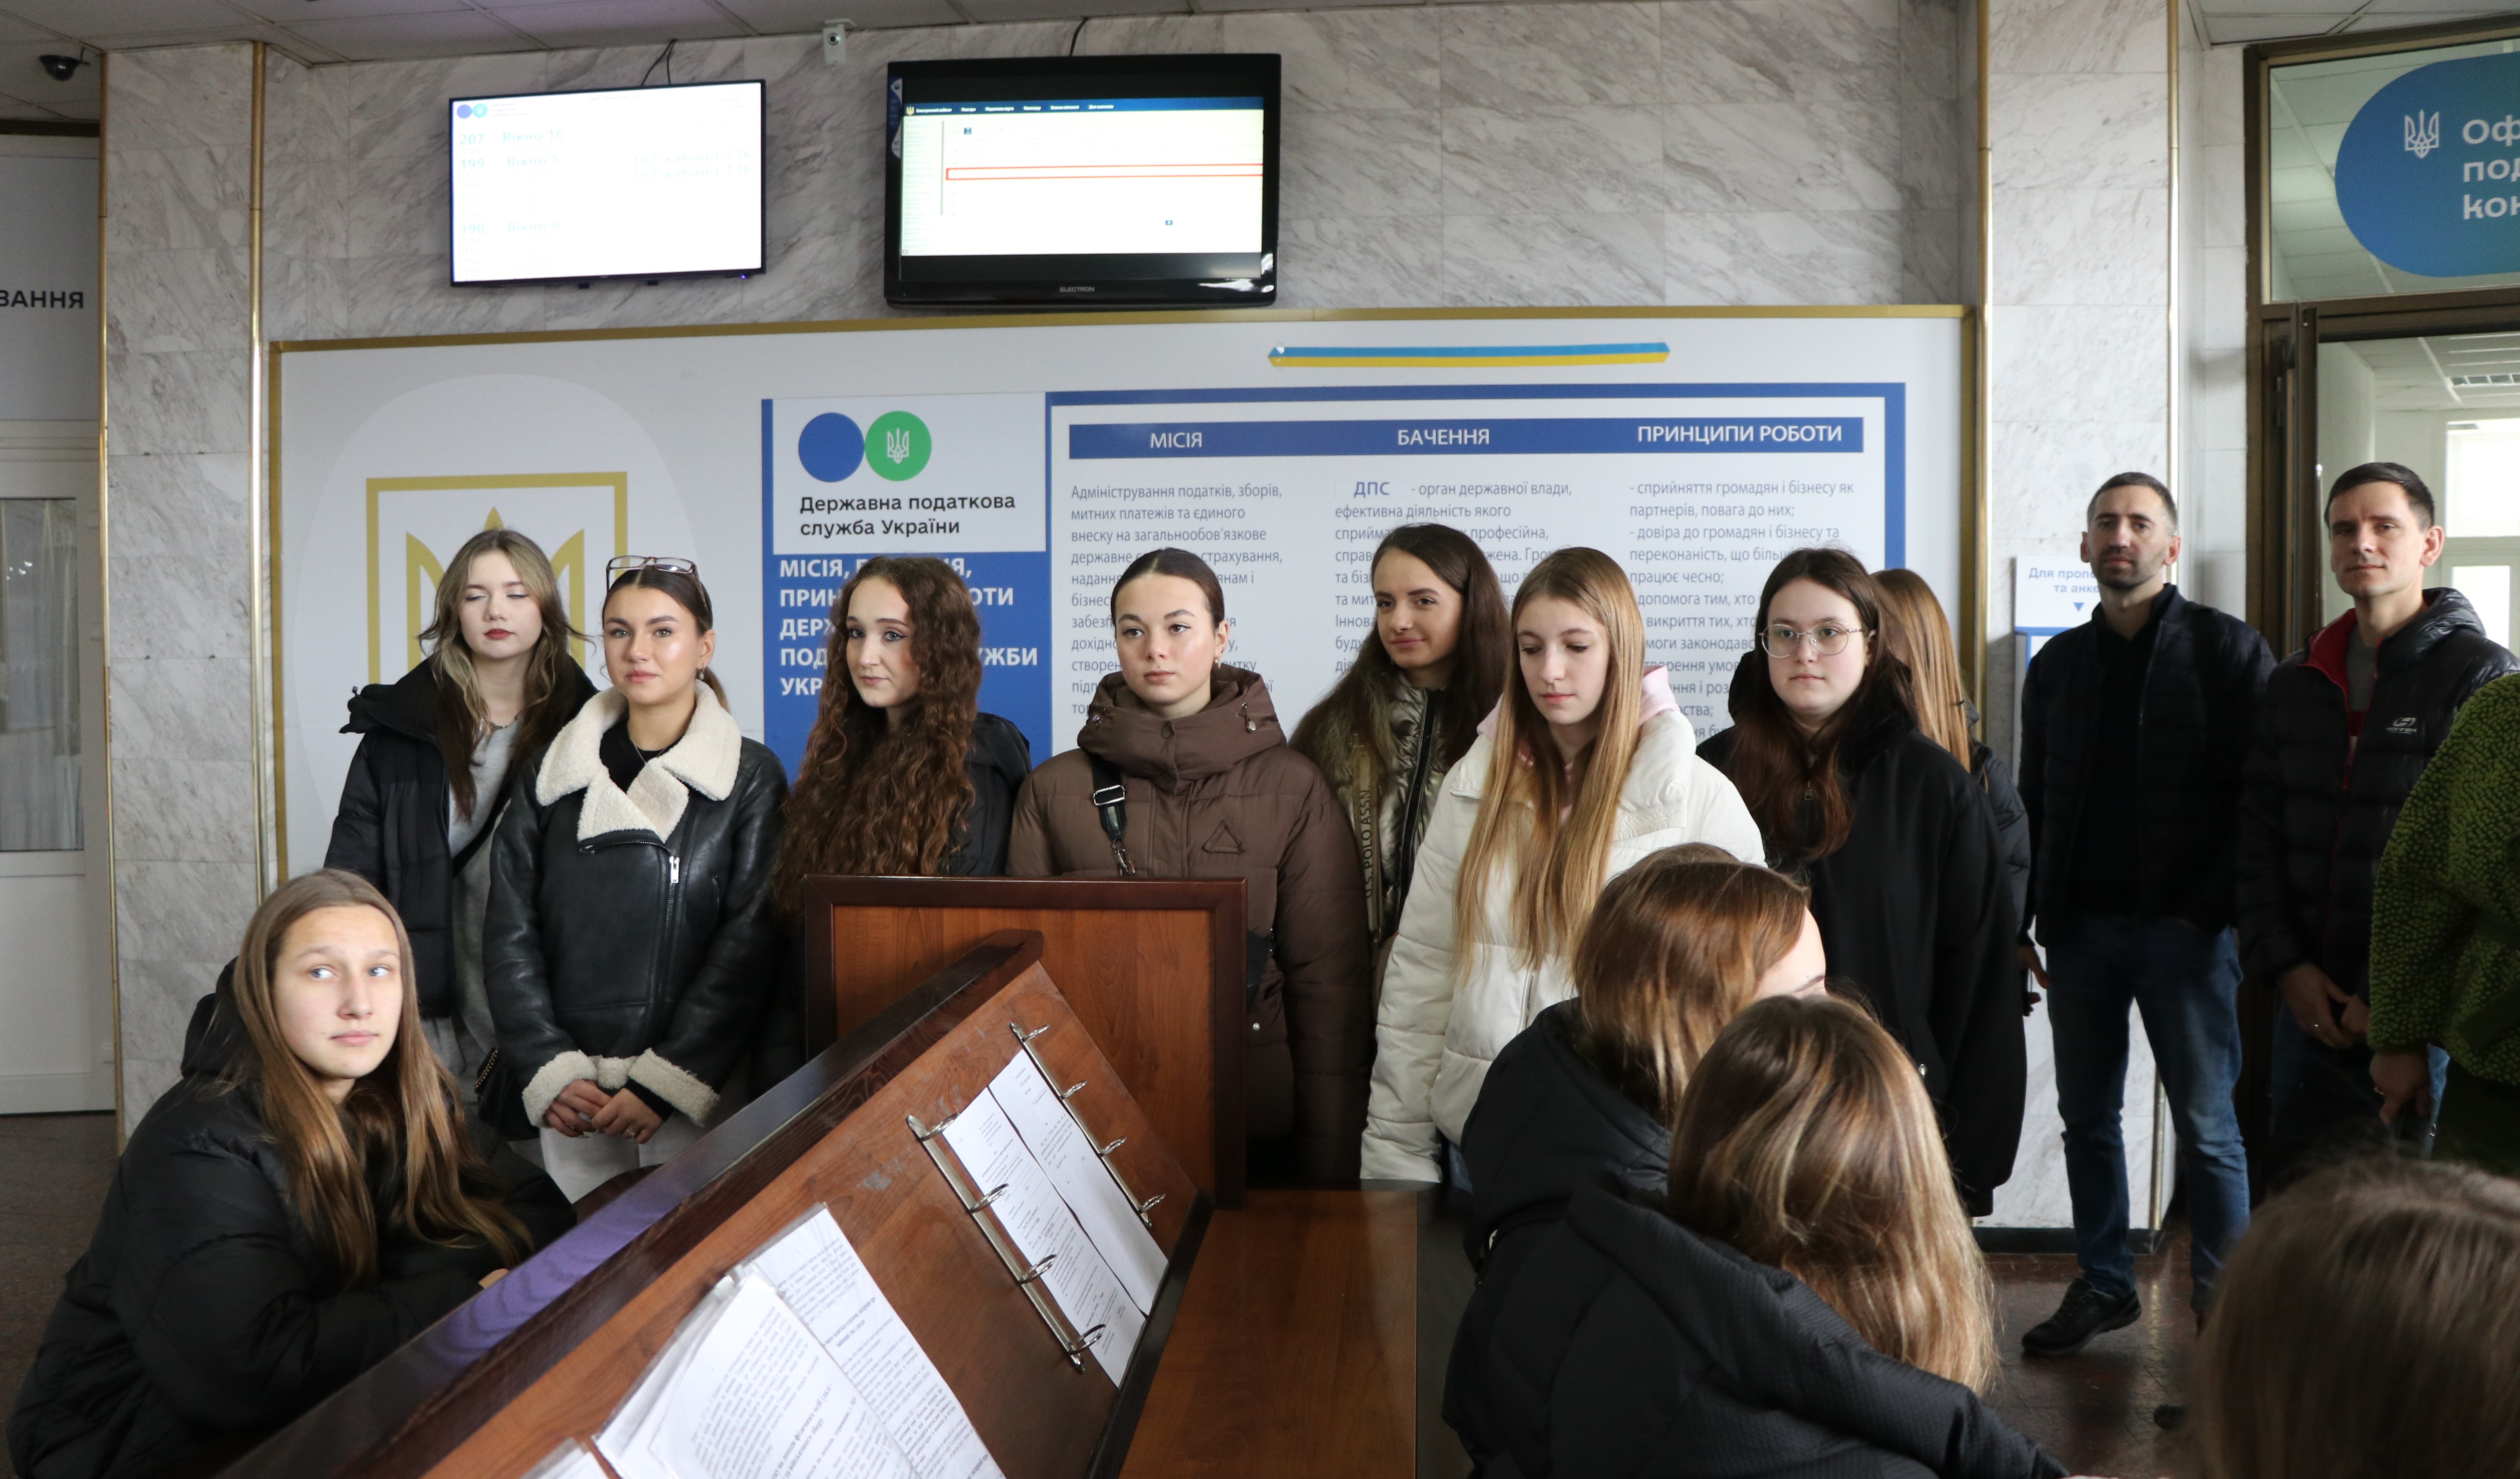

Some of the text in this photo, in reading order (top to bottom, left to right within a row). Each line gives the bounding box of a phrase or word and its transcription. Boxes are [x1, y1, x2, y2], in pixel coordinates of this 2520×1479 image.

[460, 129, 564, 145] 207 Вікно 16
[461, 154, 558, 169] 199 Вікно 5
[461, 220, 559, 234] 190 Вікно 6
[1150, 432, 1203, 448] МІСІЯ
[1398, 429, 1490, 446] БАЧЕННЯ
[1638, 425, 1842, 444] ПРИНЦИПИ РОБОТИ
[1071, 483, 1282, 501] Адміністрування податків, зборів,
[1354, 482, 1390, 498] ДПС
[1419, 485, 1456, 497] орган
[1459, 482, 1529, 496] державної
[1532, 484, 1572, 496] влади,
[1638, 481, 1713, 496] сприйняття
[1717, 484, 1778, 496] громадян
[1782, 481, 1785, 493] і
[1789, 480, 1836, 497] бізнесу
[1839, 484, 1854, 494] як
[800, 495, 1015, 514] Державна податкова
[1630, 505, 1794, 519] партнерів, повага до них;
[1071, 507, 1245, 521] митних платежів та єдиного
[1335, 505, 1511, 521] ефективна діяльність якого
[800, 519, 960, 538] служба України
[1471, 524, 1549, 539] професійна,
[1638, 527, 1680, 541] довіра
[1684, 528, 1700, 541] до
[1703, 528, 1766, 541] громадян
[1769, 525, 1772, 538] і
[1776, 525, 1823, 541] бізнесу
[1827, 528, 1839, 538] та
[1071, 531, 1113, 545] внеску
[1116, 531, 1131, 541] на
[1071, 552, 1132, 566] державне
[1202, 551, 1283, 563] страхування,
[1630, 549, 1727, 563] переконаність,
[1731, 550, 1750, 562] що
[780, 559, 850, 579] МІСІЯ,
[2029, 567, 2054, 579] Для
[1335, 573, 1349, 583] та
[1501, 573, 1520, 585] що
[1630, 572, 1724, 586] працює чесно;
[1072, 594, 1111, 606] бізнес
[1335, 595, 1349, 605] та
[1638, 594, 1755, 608] допомога тим, хто
[1646, 617, 1706, 630] викриття
[1710, 617, 1733, 629] тих,
[1071, 638, 1118, 652] дохідно
[1646, 639, 1755, 652] моги законодавс
[1072, 660, 1122, 674] створен
[1361, 829, 1373, 869] POLO
[1364, 872, 1373, 899] U.S.
[793, 1411, 816, 1442] фізичних
